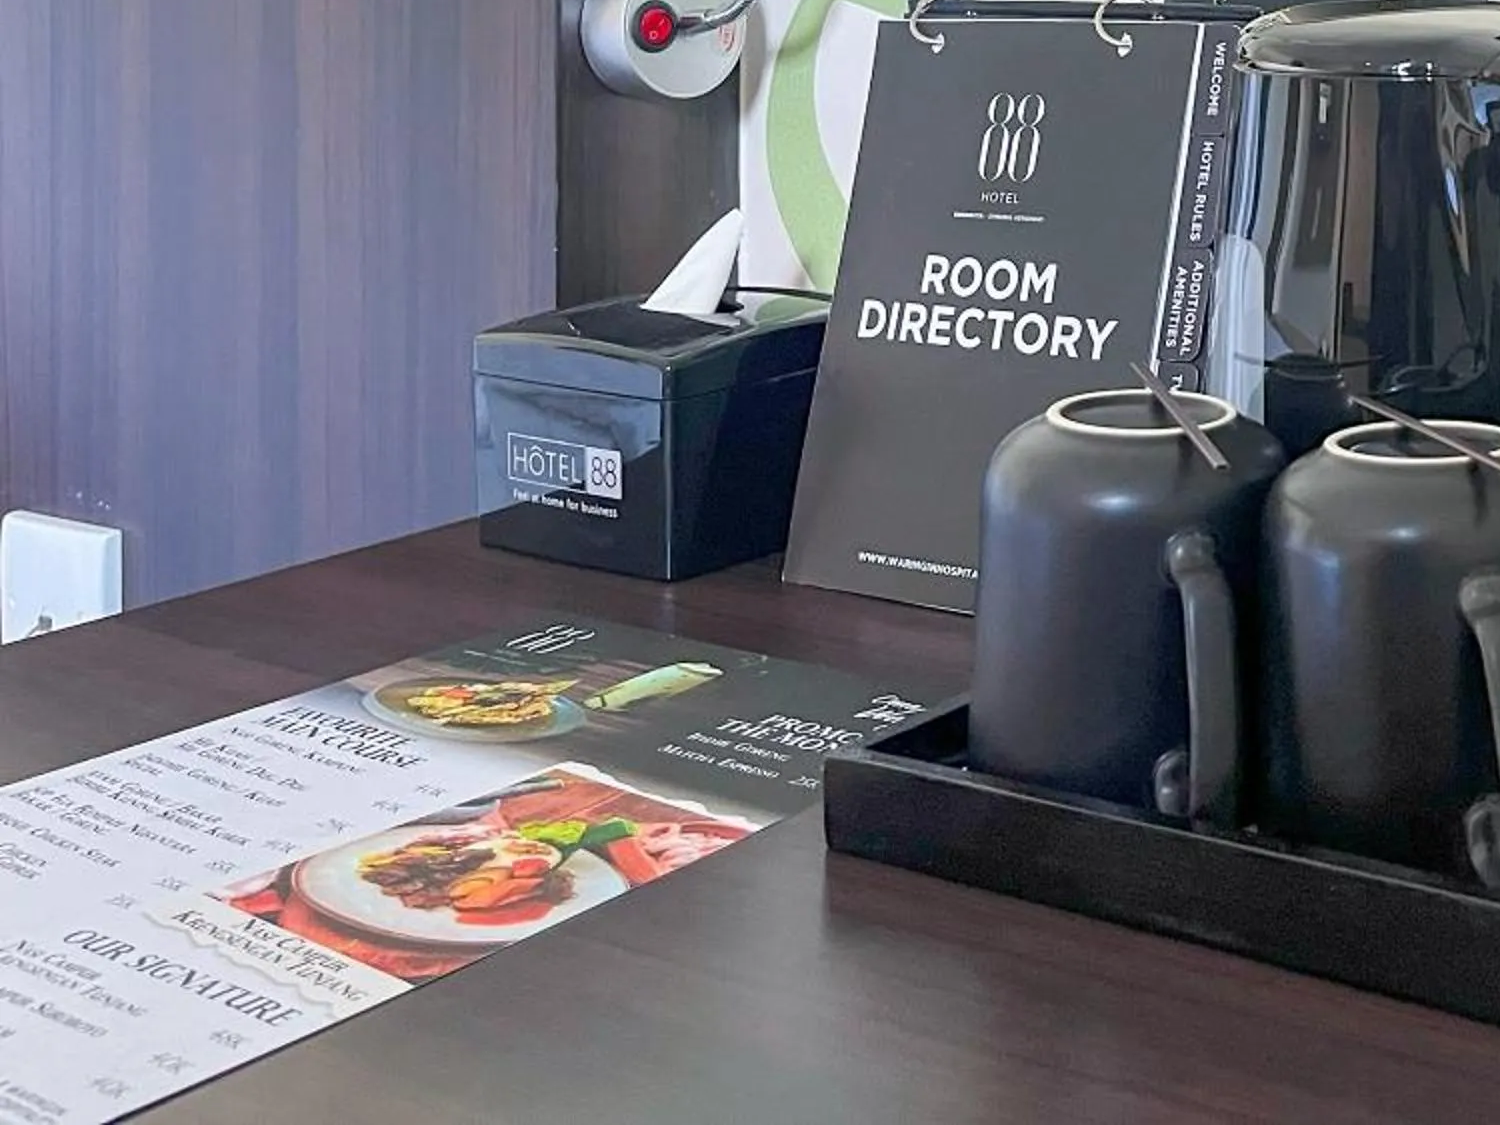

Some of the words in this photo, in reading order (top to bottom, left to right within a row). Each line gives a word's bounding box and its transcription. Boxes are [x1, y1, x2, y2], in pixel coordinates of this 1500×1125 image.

[1206, 42, 1227, 117] WELCOME
[977, 92, 1047, 183] 88
[1196, 141, 1215, 190] HOTEL
[980, 191, 1021, 204] HOTEL
[1189, 194, 1208, 242] RULES
[920, 253, 1058, 305] ROOM
[856, 298, 1120, 361] DIRECTORY
[1165, 266, 1188, 348] AMENITIES
[1179, 260, 1205, 356] ADDITIONAL
[513, 444, 583, 484] HÔTEL
[591, 456, 618, 488] 88
[541, 494, 565, 509] home
[565, 497, 579, 511] for
[581, 500, 619, 518] business
[321, 734, 428, 768] COURSE
[716, 718, 770, 740] THE
[63, 929, 136, 962] OUR
[124, 954, 303, 1027] SIGNATURE
